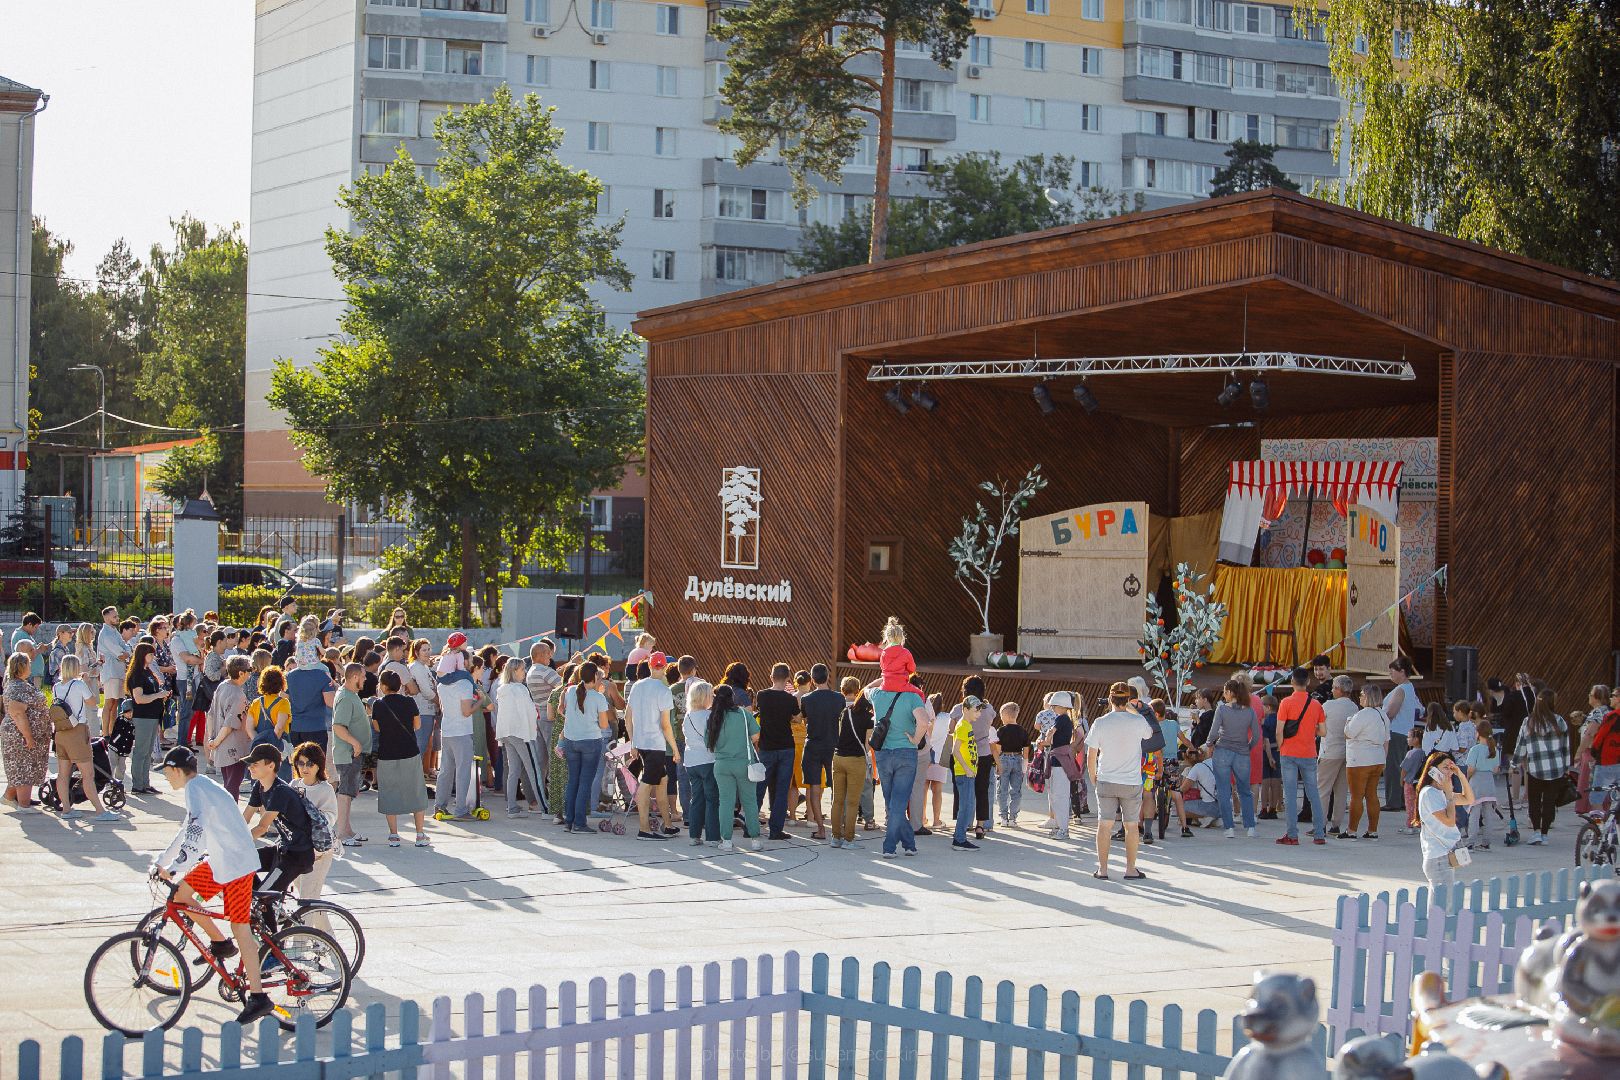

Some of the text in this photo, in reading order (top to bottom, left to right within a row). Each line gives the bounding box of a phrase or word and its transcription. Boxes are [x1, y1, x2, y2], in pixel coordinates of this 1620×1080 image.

[1051, 508, 1138, 545] БУРА
[1349, 511, 1387, 552] ТИНО
[684, 575, 792, 603] Дулёвский
[693, 612, 787, 627] ПАРК КУЛЬТУРЫ И ОТДЫХА
